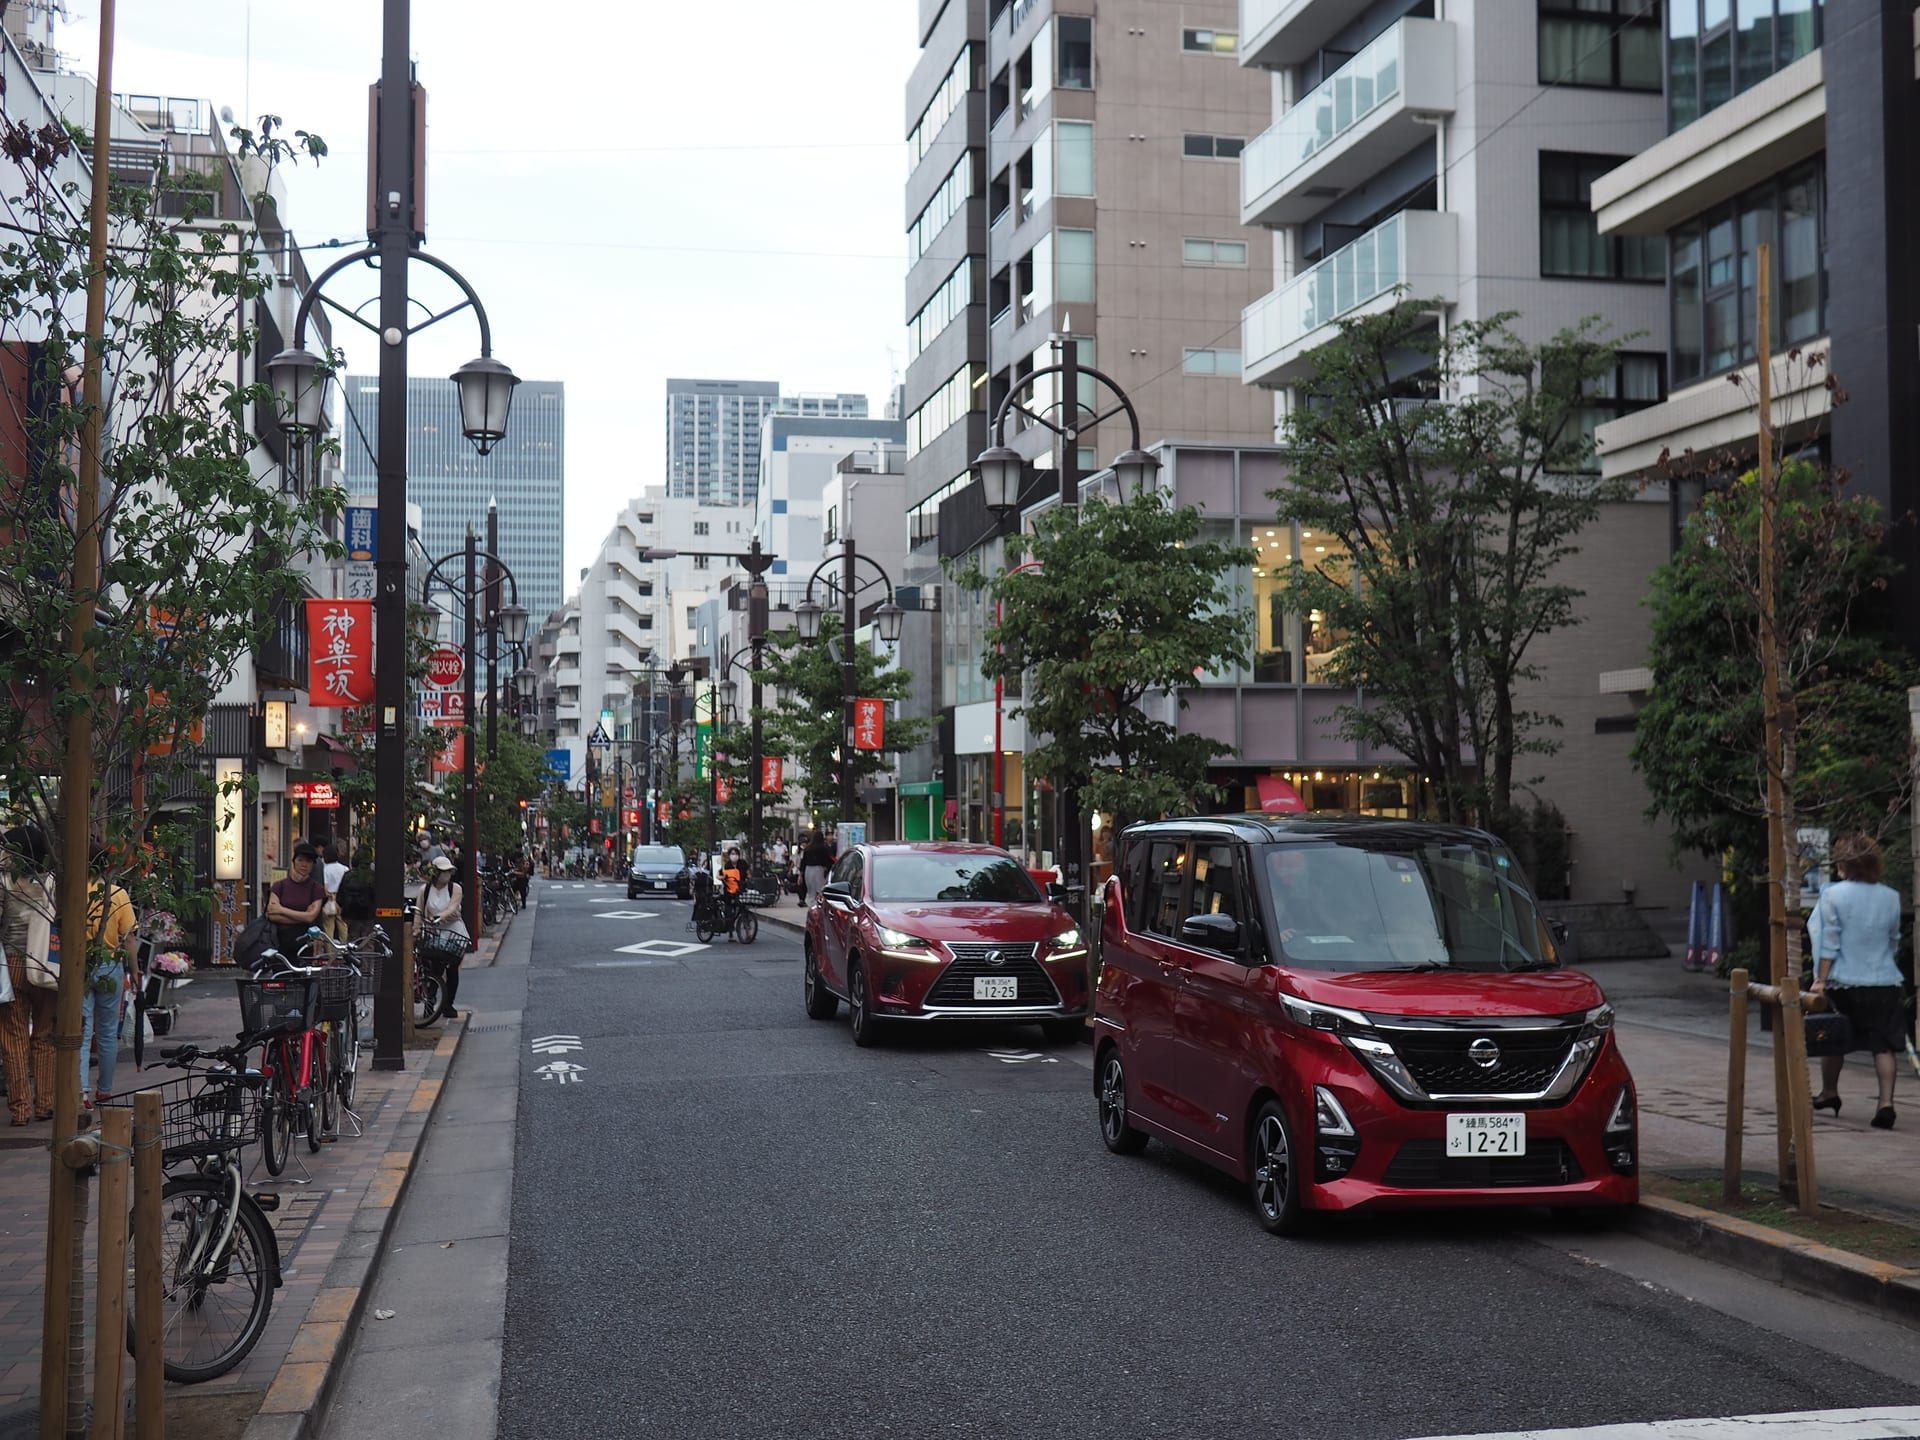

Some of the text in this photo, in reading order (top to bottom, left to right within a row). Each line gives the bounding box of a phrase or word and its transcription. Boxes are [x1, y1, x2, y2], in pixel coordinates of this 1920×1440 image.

[351, 509, 372, 550] 歯科
[314, 606, 361, 703] 神楽坂
[858, 702, 877, 748] 神楽坂
[985, 986, 1015, 998] 12-25
[1450, 1131, 1518, 1153] ふ 12-21
